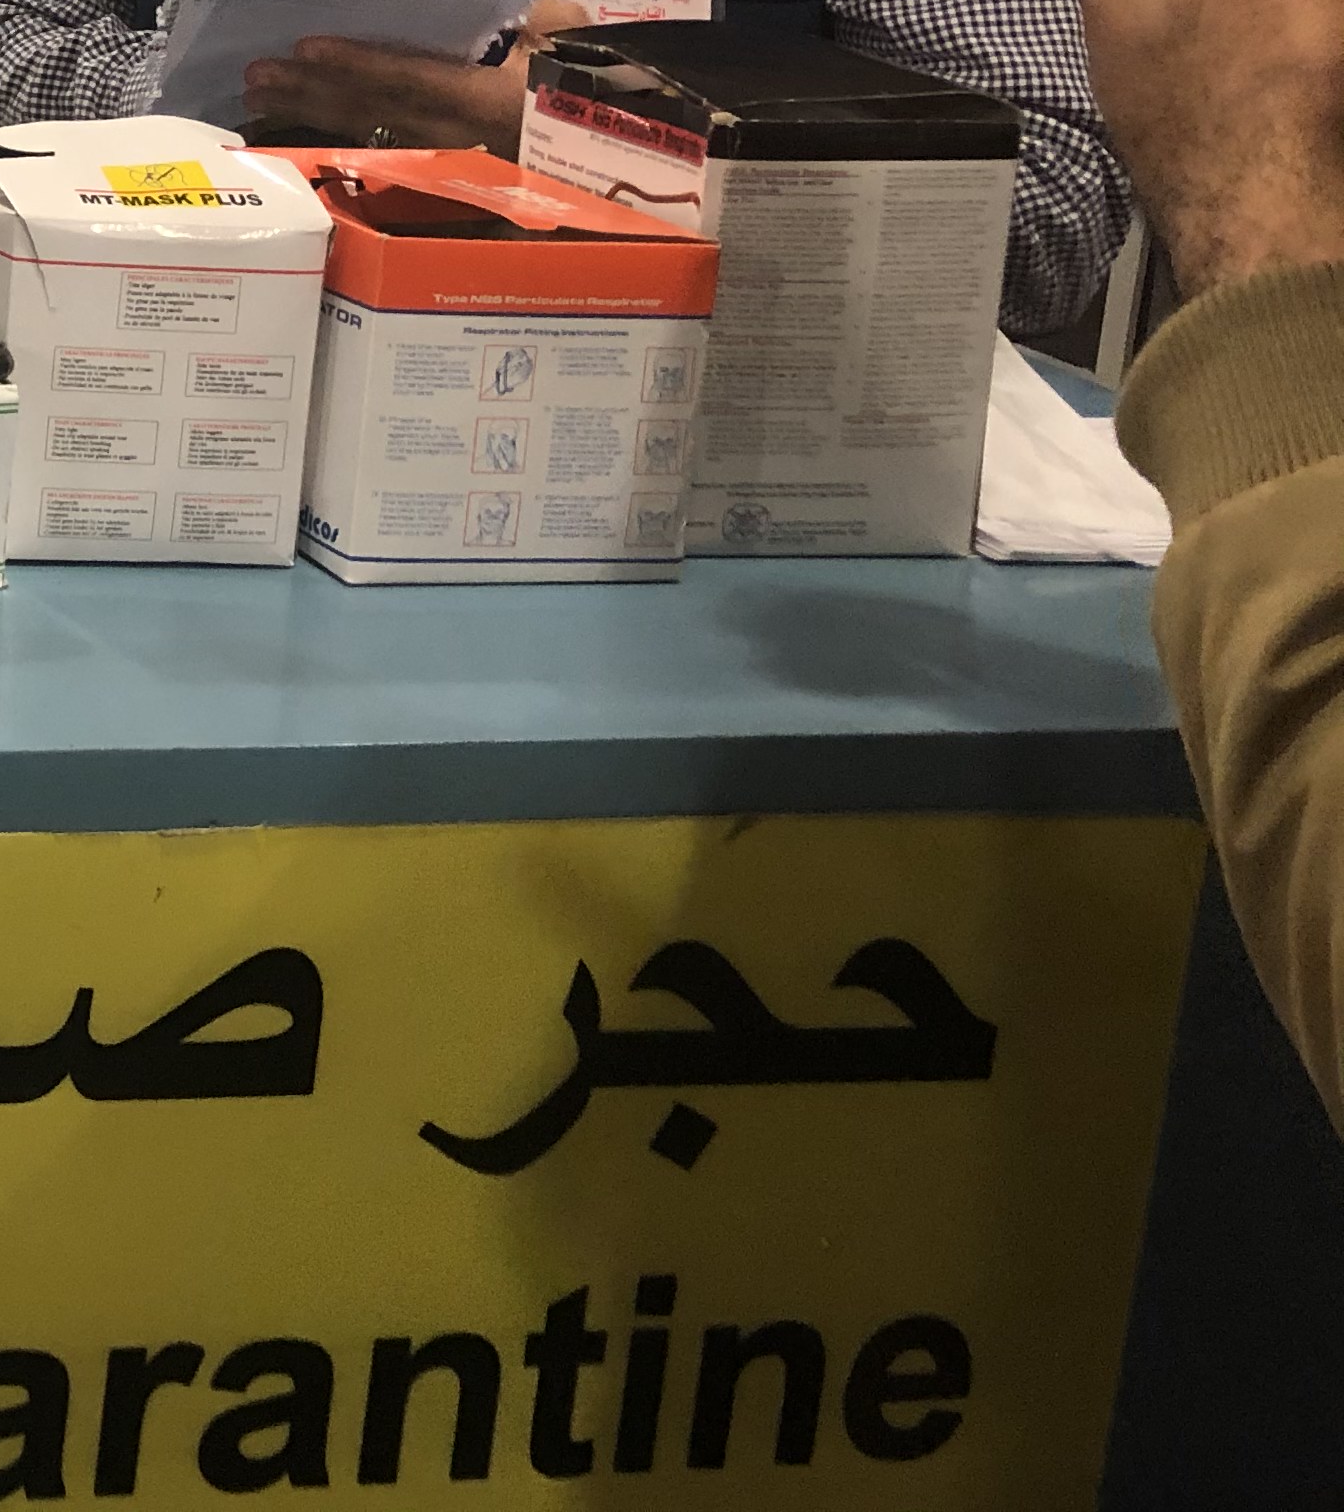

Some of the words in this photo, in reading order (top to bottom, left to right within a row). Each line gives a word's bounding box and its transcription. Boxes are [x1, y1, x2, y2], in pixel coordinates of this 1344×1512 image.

[80, 193, 193, 206] MT-MASK
[199, 192, 264, 207] PLUS
[434, 294, 468, 304] Type
[506, 296, 584, 305] Particulate
[587, 298, 662, 307] Respirator
[418, 936, 1000, 1174] حجر
